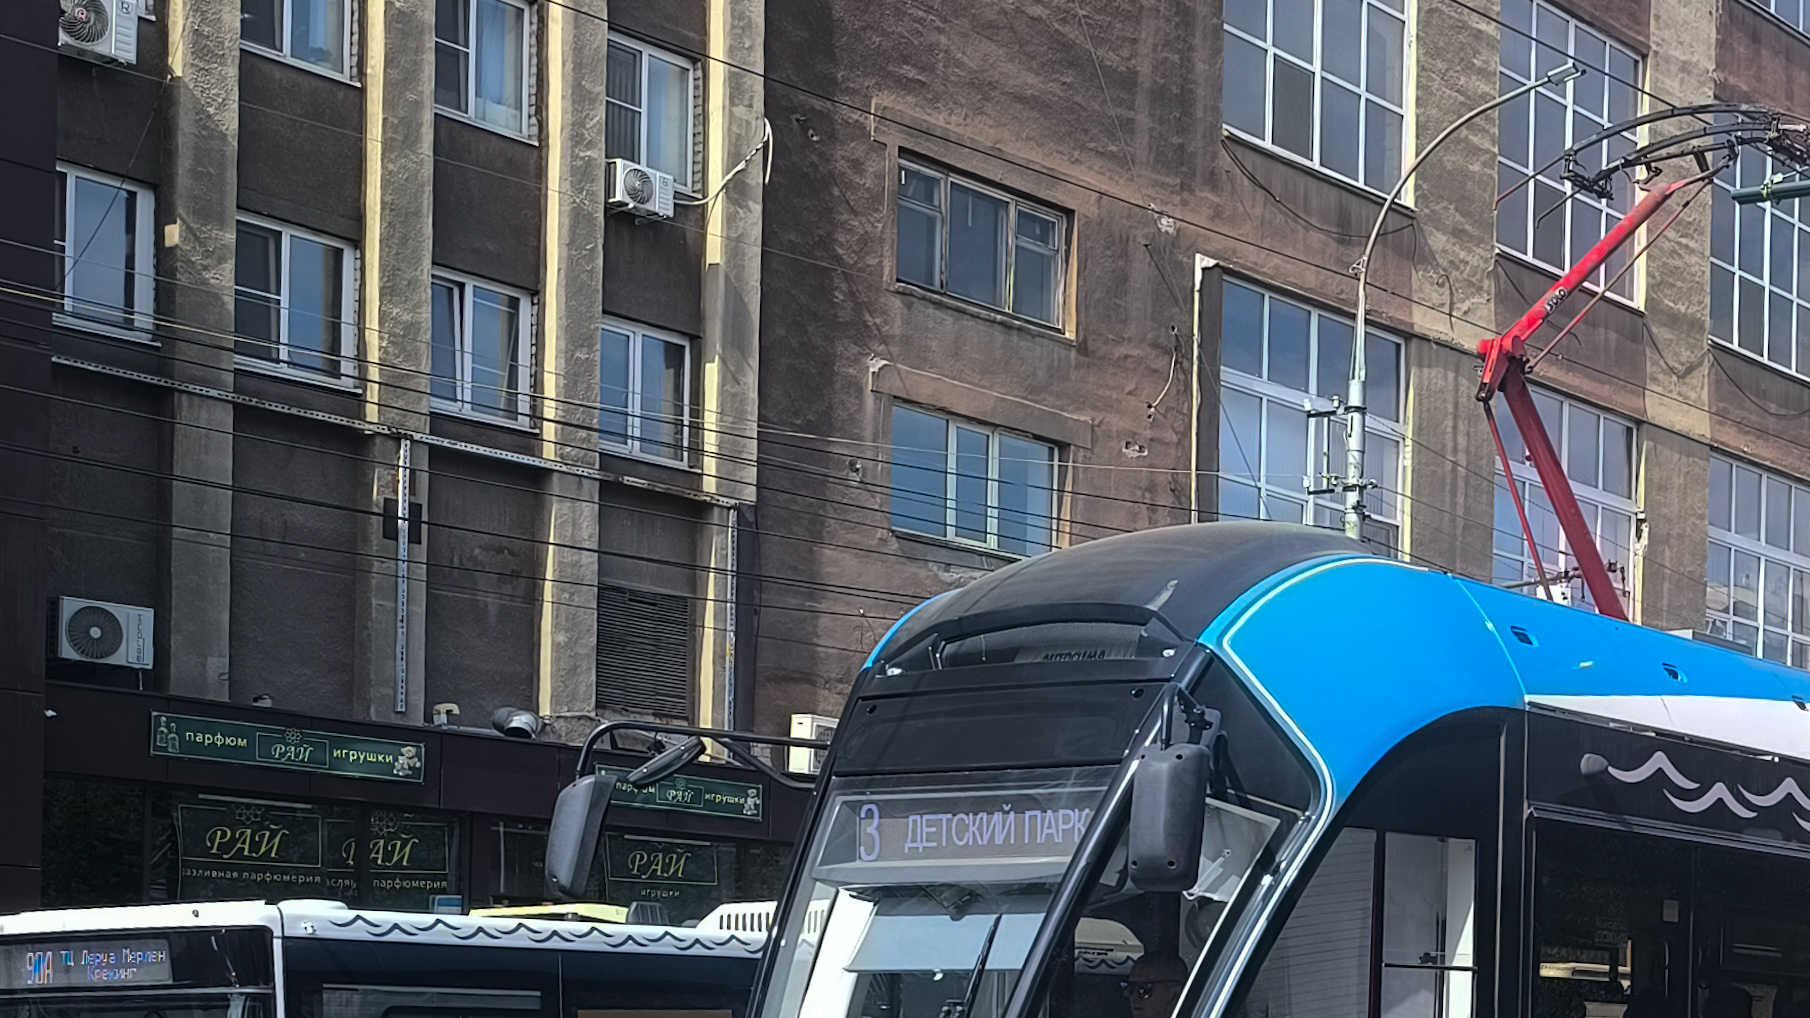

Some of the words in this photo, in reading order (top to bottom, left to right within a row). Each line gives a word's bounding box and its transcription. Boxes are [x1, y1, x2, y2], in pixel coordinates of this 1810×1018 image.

[185, 731, 248, 748] парфюм
[270, 741, 314, 763] РАЙ
[332, 747, 394, 764] игрушки
[615, 781, 656, 795] парм
[205, 823, 290, 859] РАЙ
[860, 803, 882, 862] 3
[904, 803, 1016, 853] ДЕТСКИЙ
[1024, 808, 1091, 845] ПАРК
[242, 871, 321, 886] парфюмерия
[628, 846, 692, 879] РАЙ
[373, 877, 448, 891] парфюмерия
[60, 951, 74, 967] ТЦ
[82, 950, 116, 967] Леруа
[122, 948, 166, 964] Мерлен
